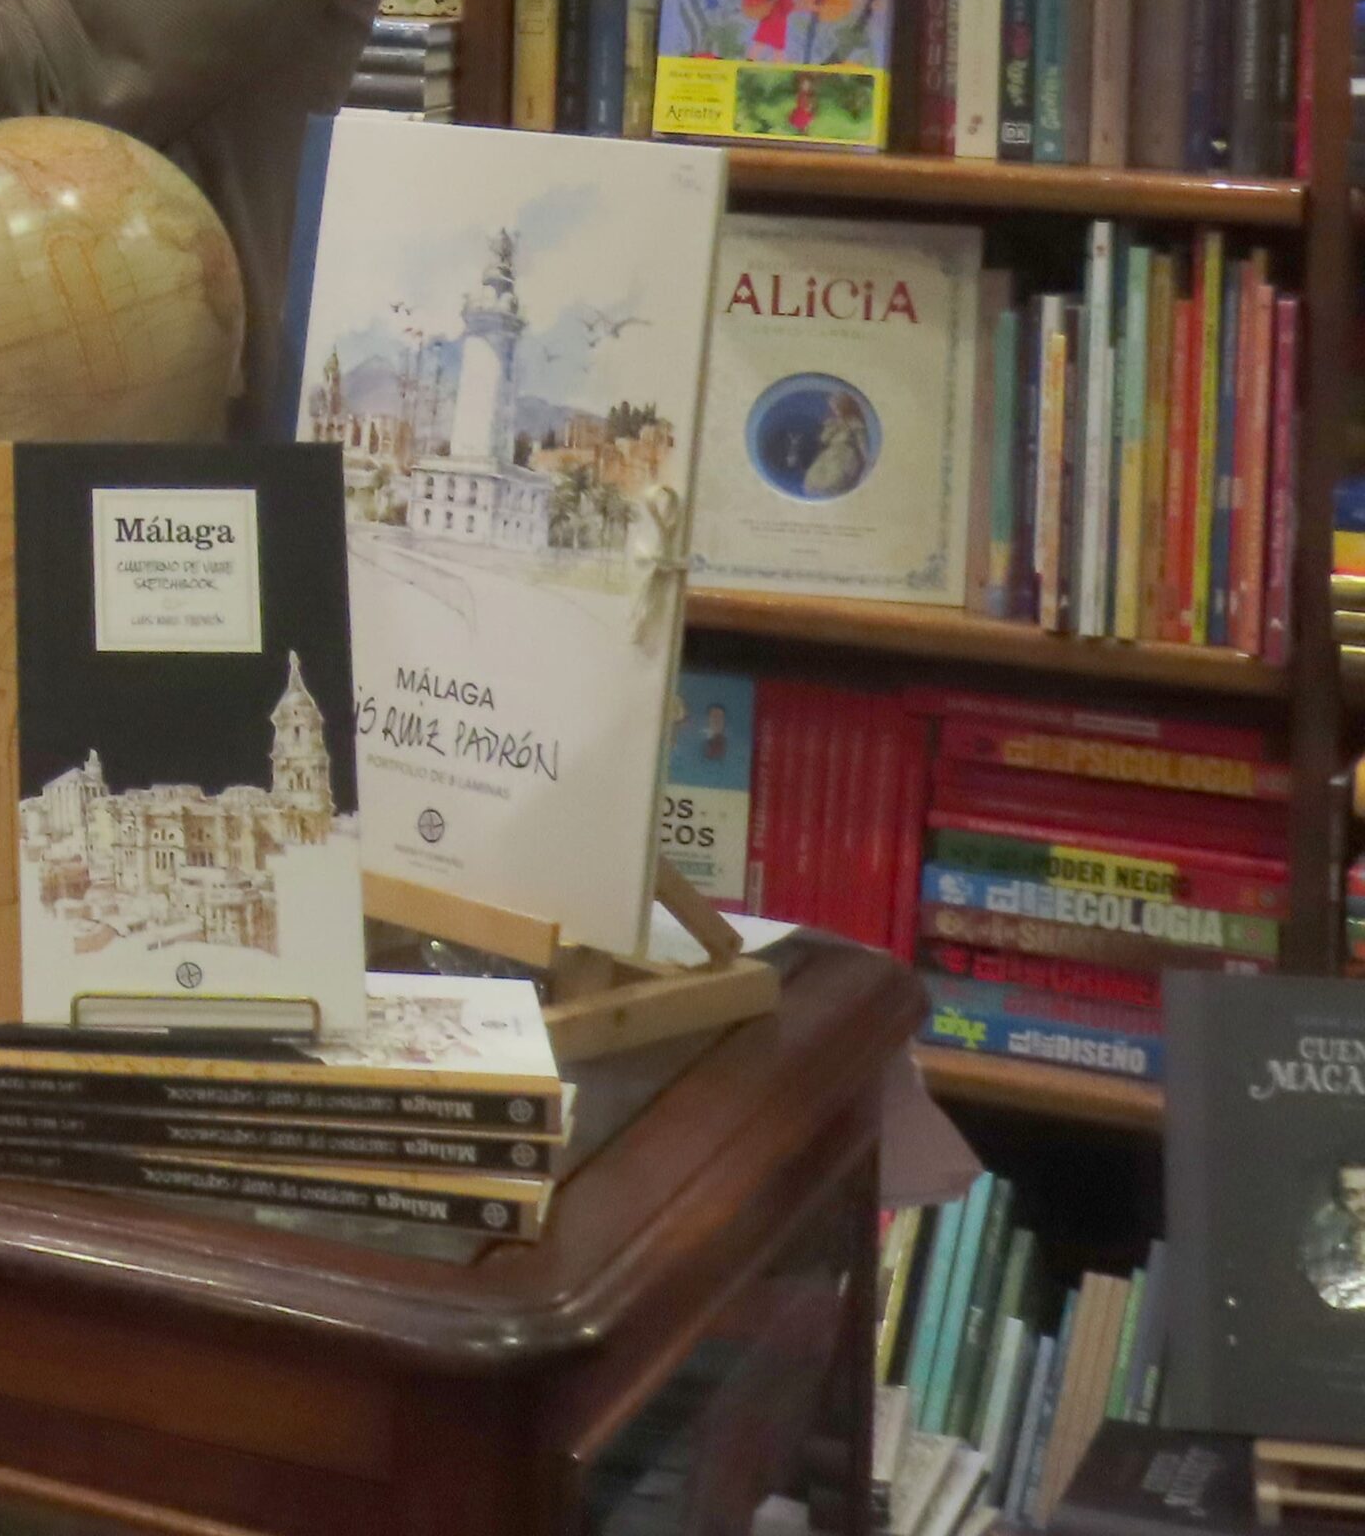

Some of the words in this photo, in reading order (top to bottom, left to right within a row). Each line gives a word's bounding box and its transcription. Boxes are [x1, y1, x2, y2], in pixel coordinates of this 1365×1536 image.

[115, 515, 235, 551] Málaga
[396, 667, 495, 712] MÁLAGA
[1060, 1033, 1148, 1075] DISEÑO
[401, 1097, 474, 1120] Málaga
[403, 1139, 476, 1163] Málaga
[375, 1192, 448, 1219] Málaga
